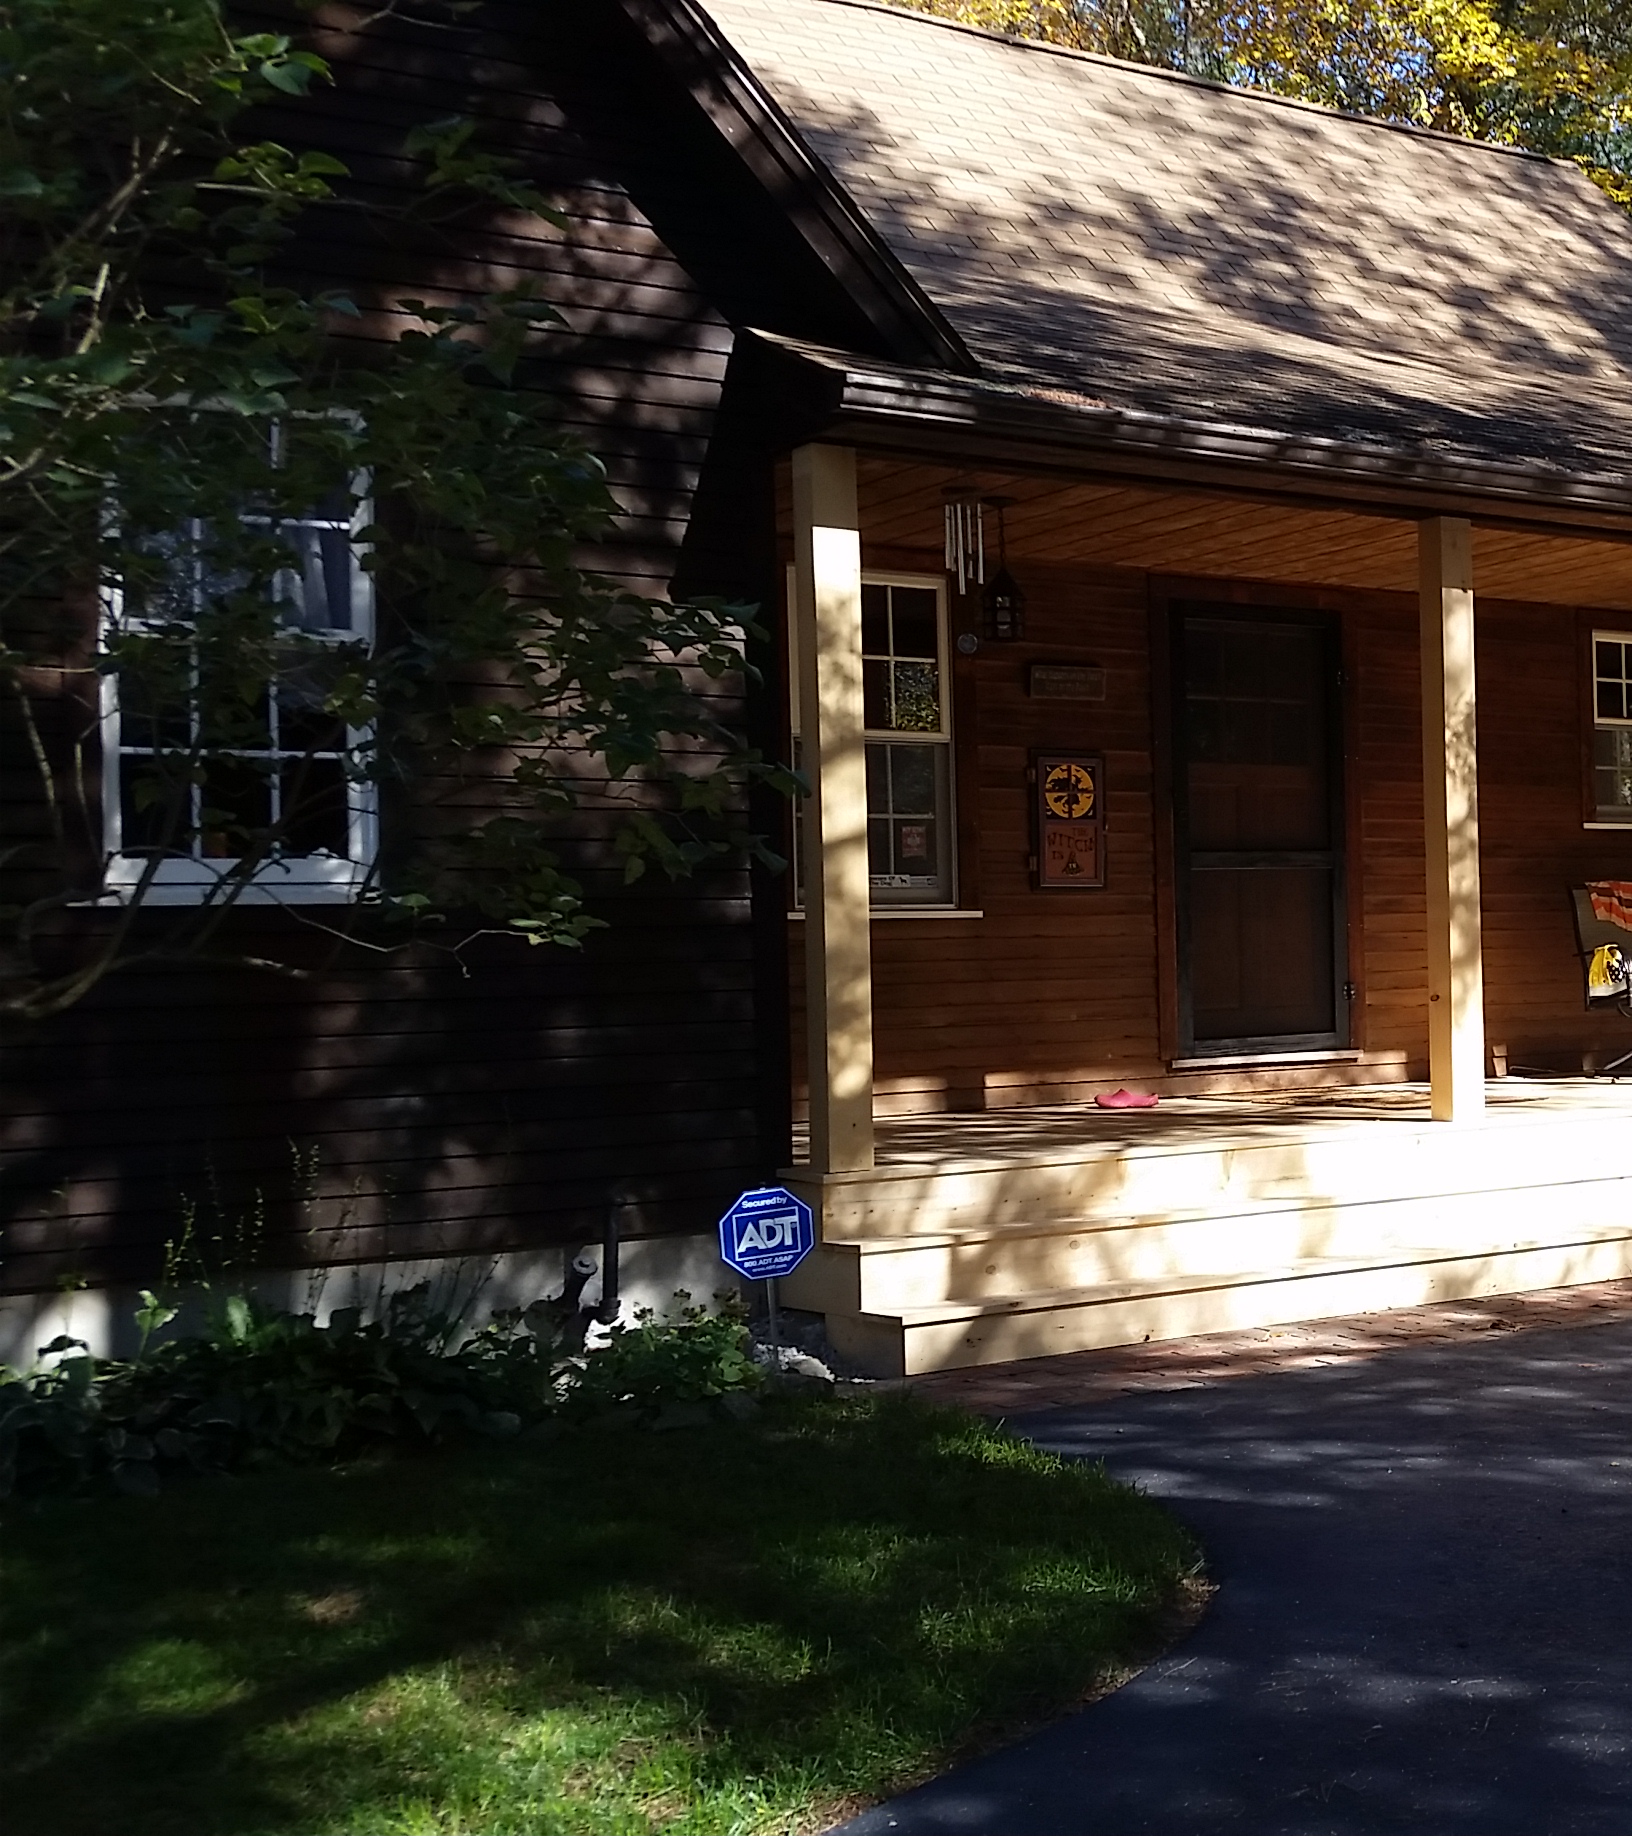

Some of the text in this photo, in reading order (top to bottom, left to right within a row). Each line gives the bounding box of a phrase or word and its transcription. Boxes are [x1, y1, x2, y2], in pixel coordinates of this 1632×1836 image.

[1048, 833, 1093, 852] WITCH
[741, 1196, 787, 1208] Secured by
[738, 1216, 797, 1252] ADT
